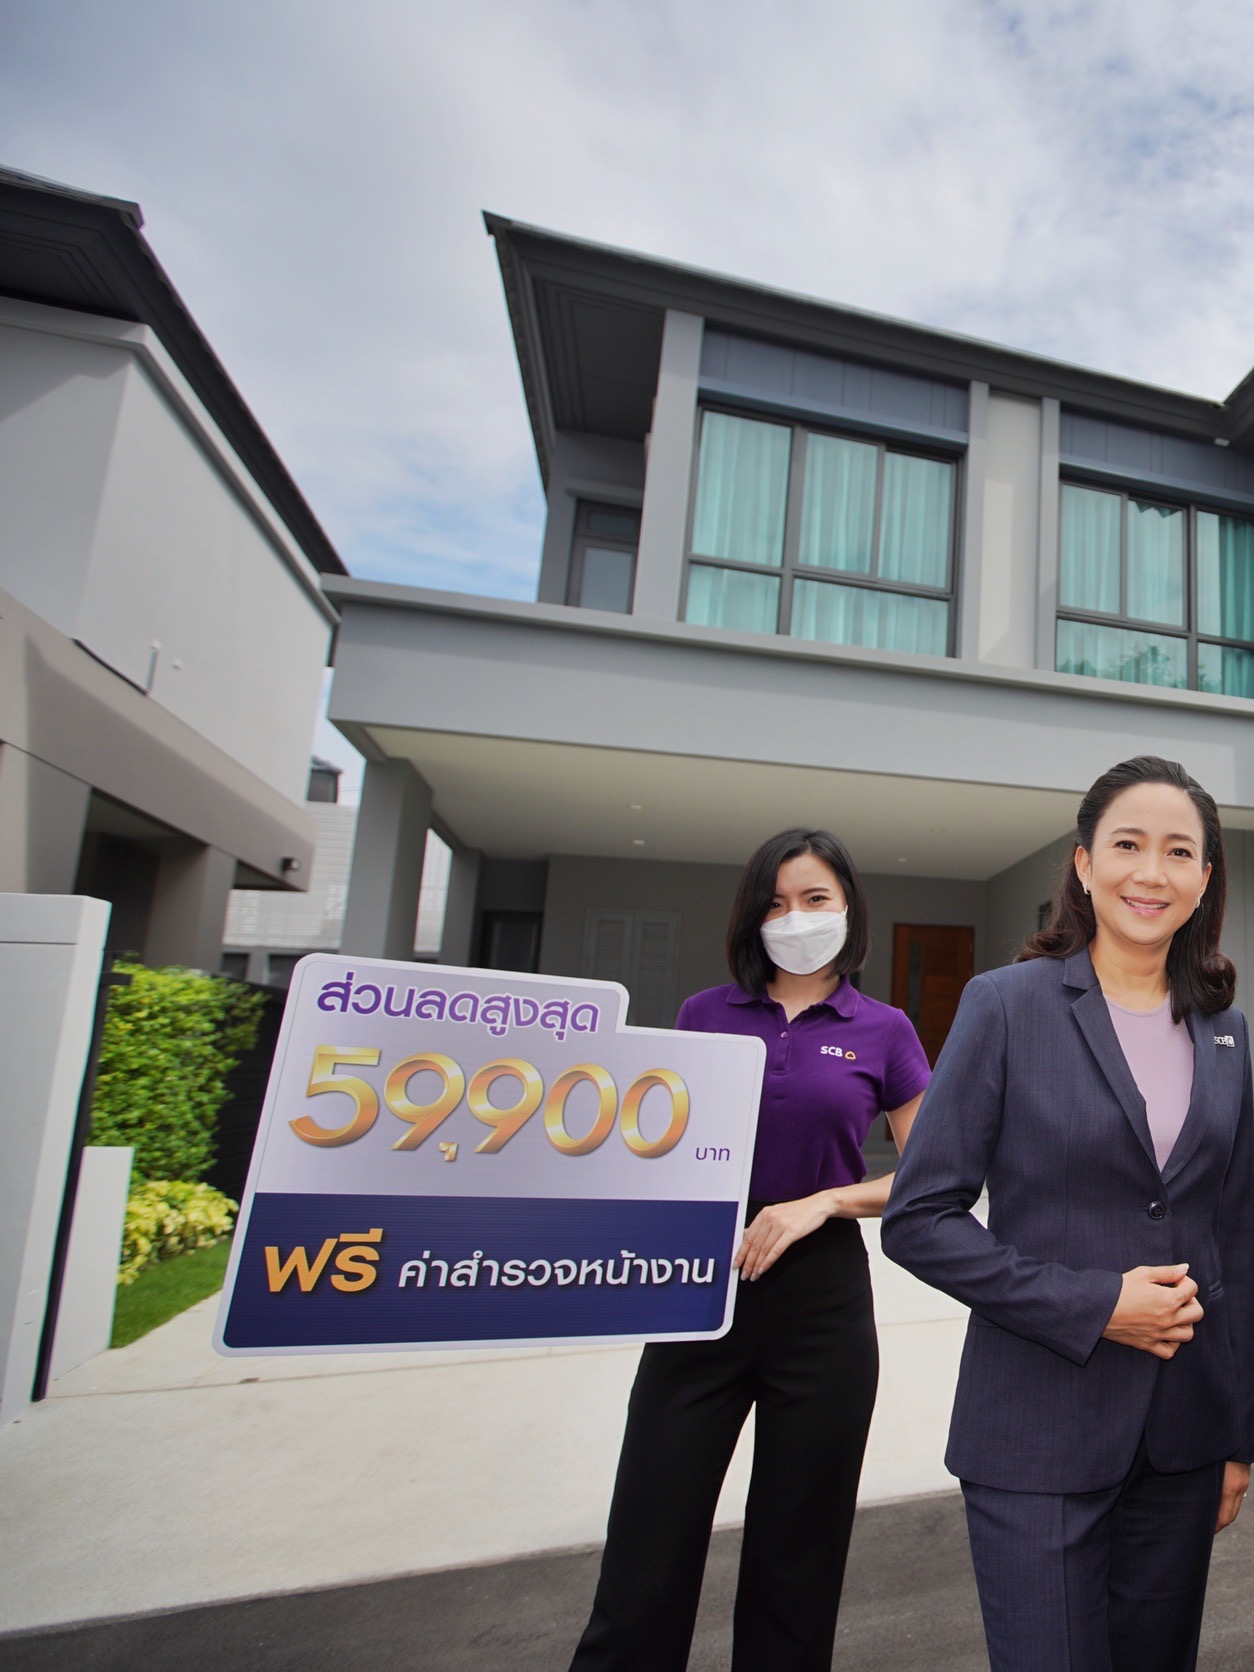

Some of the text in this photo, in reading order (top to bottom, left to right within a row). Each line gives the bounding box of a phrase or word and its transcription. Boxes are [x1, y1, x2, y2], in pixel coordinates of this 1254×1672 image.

[316, 972, 599, 1039] ส่วนลดสูงสุด
[820, 1045, 843, 1057] SCB
[288, 1045, 731, 1163] 59,900 บาท
[264, 1228, 715, 1293] ฟรี ค่าสำรวจหน้างาน
